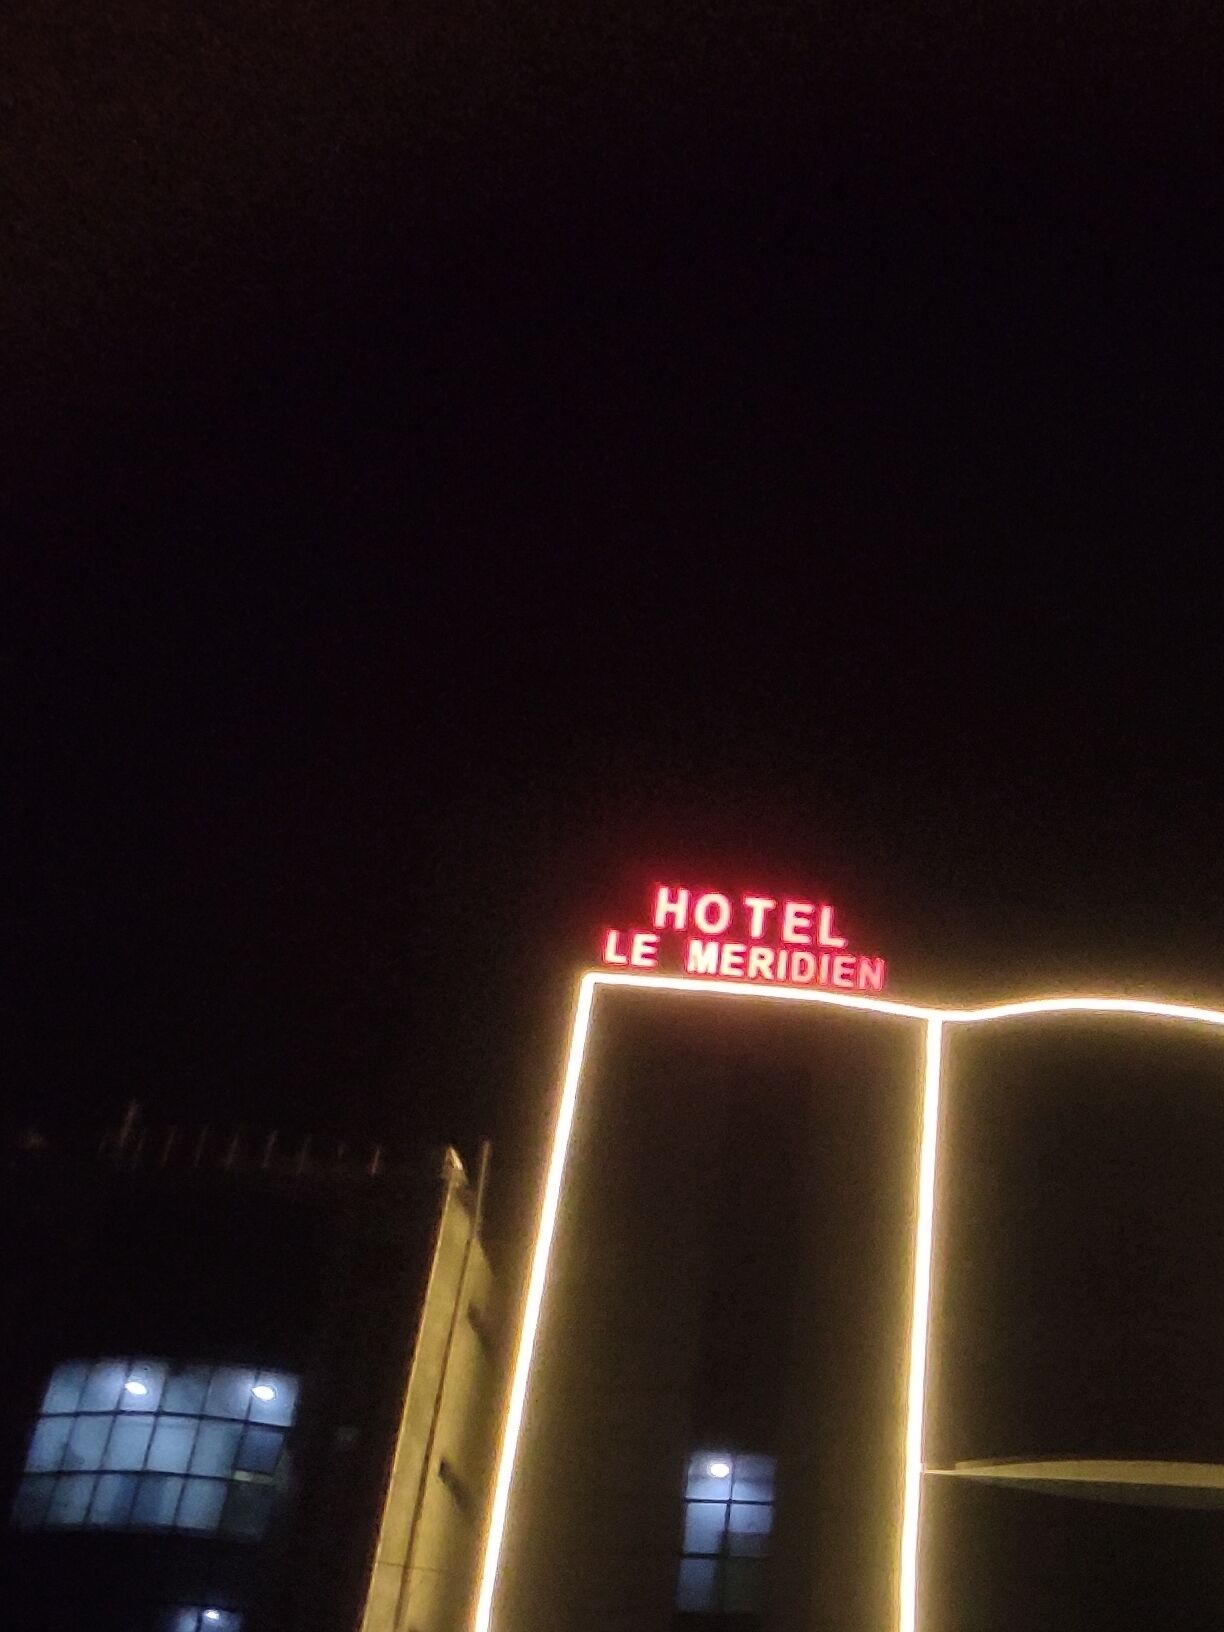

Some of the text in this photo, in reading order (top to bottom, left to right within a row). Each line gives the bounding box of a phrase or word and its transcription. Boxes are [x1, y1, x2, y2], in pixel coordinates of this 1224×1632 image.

[653, 885, 849, 950] HOTEL
[602, 928, 885, 991] LE MERIDIEN
